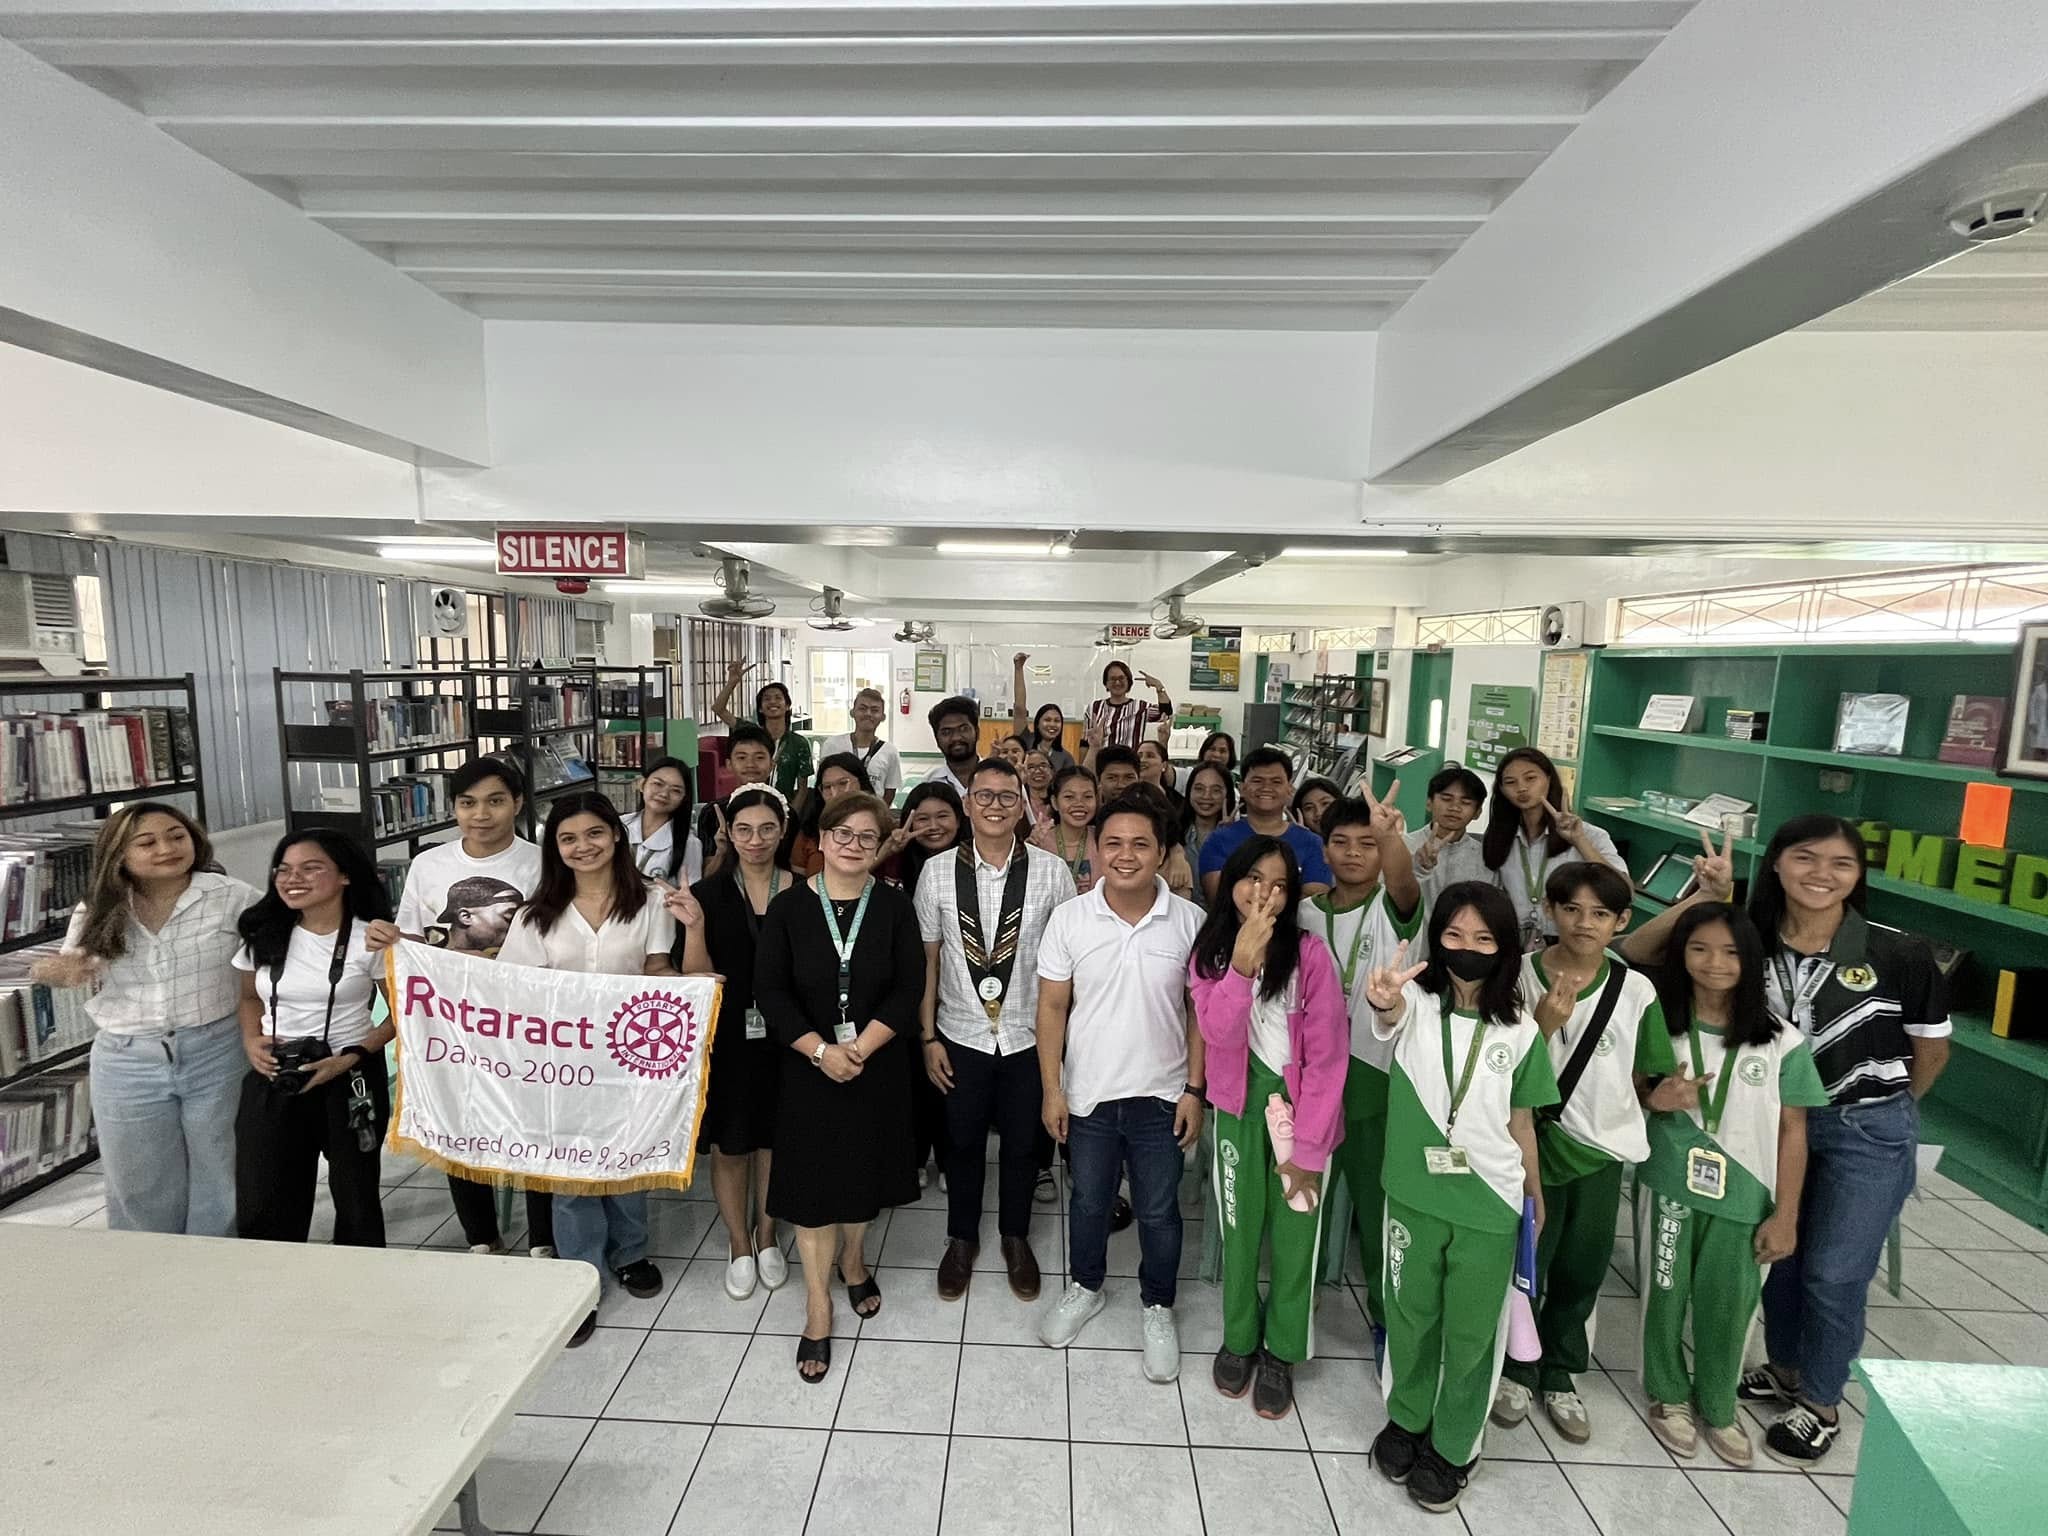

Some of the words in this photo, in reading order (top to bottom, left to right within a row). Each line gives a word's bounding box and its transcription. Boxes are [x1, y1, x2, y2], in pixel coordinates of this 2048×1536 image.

[502, 535, 618, 568] SILENCE
[1111, 626, 1150, 637] SILENCE
[404, 975, 594, 1050] Rotaract
[636, 1001, 675, 1011] ROTARY
[425, 1037, 511, 1079] Davao
[521, 1060, 594, 1087] 2000
[620, 1049, 681, 1070] INTERNATIONAL
[509, 1142, 539, 1159] on
[545, 1140, 593, 1164] June
[597, 1146, 613, 1171] 9,
[616, 1140, 670, 1170] 2023
